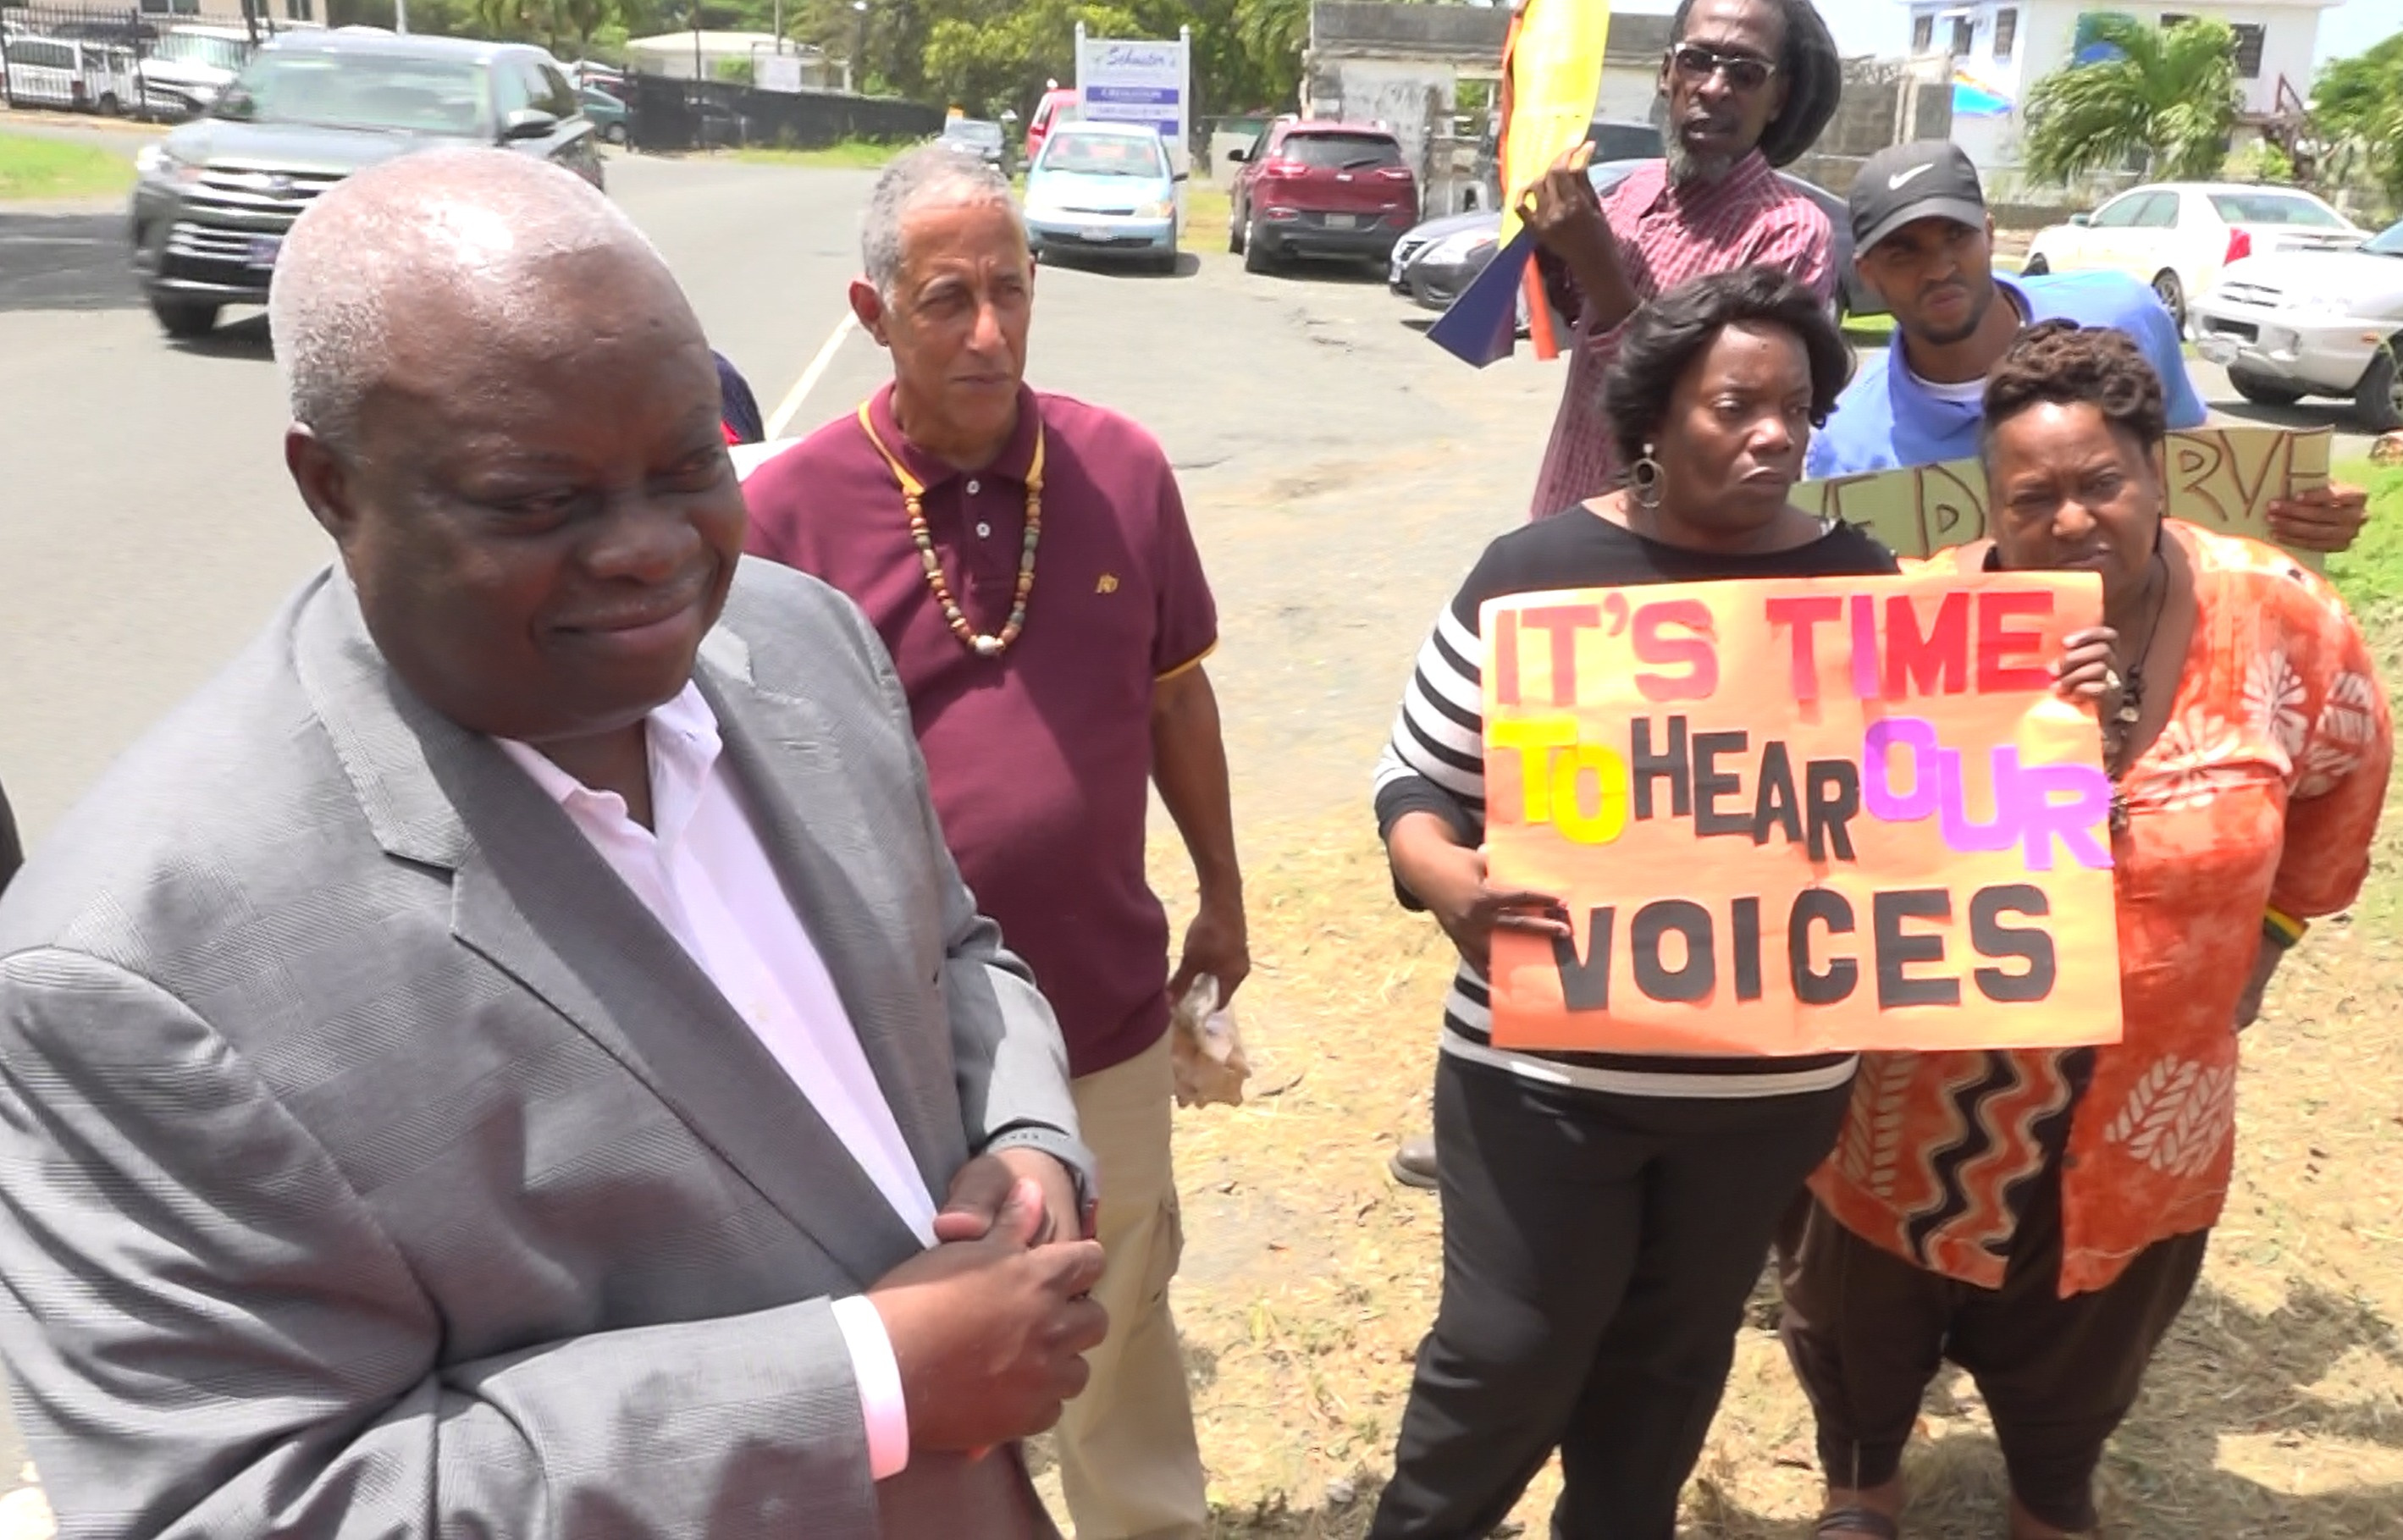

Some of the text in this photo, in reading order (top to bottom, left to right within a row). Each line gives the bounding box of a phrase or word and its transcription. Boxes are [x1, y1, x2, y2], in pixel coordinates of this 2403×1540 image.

[1494, 590, 2055, 707] IT'S TIME
[1489, 715, 2114, 871] TO HEAR OUR
[1550, 883, 2057, 1013] VOICES
